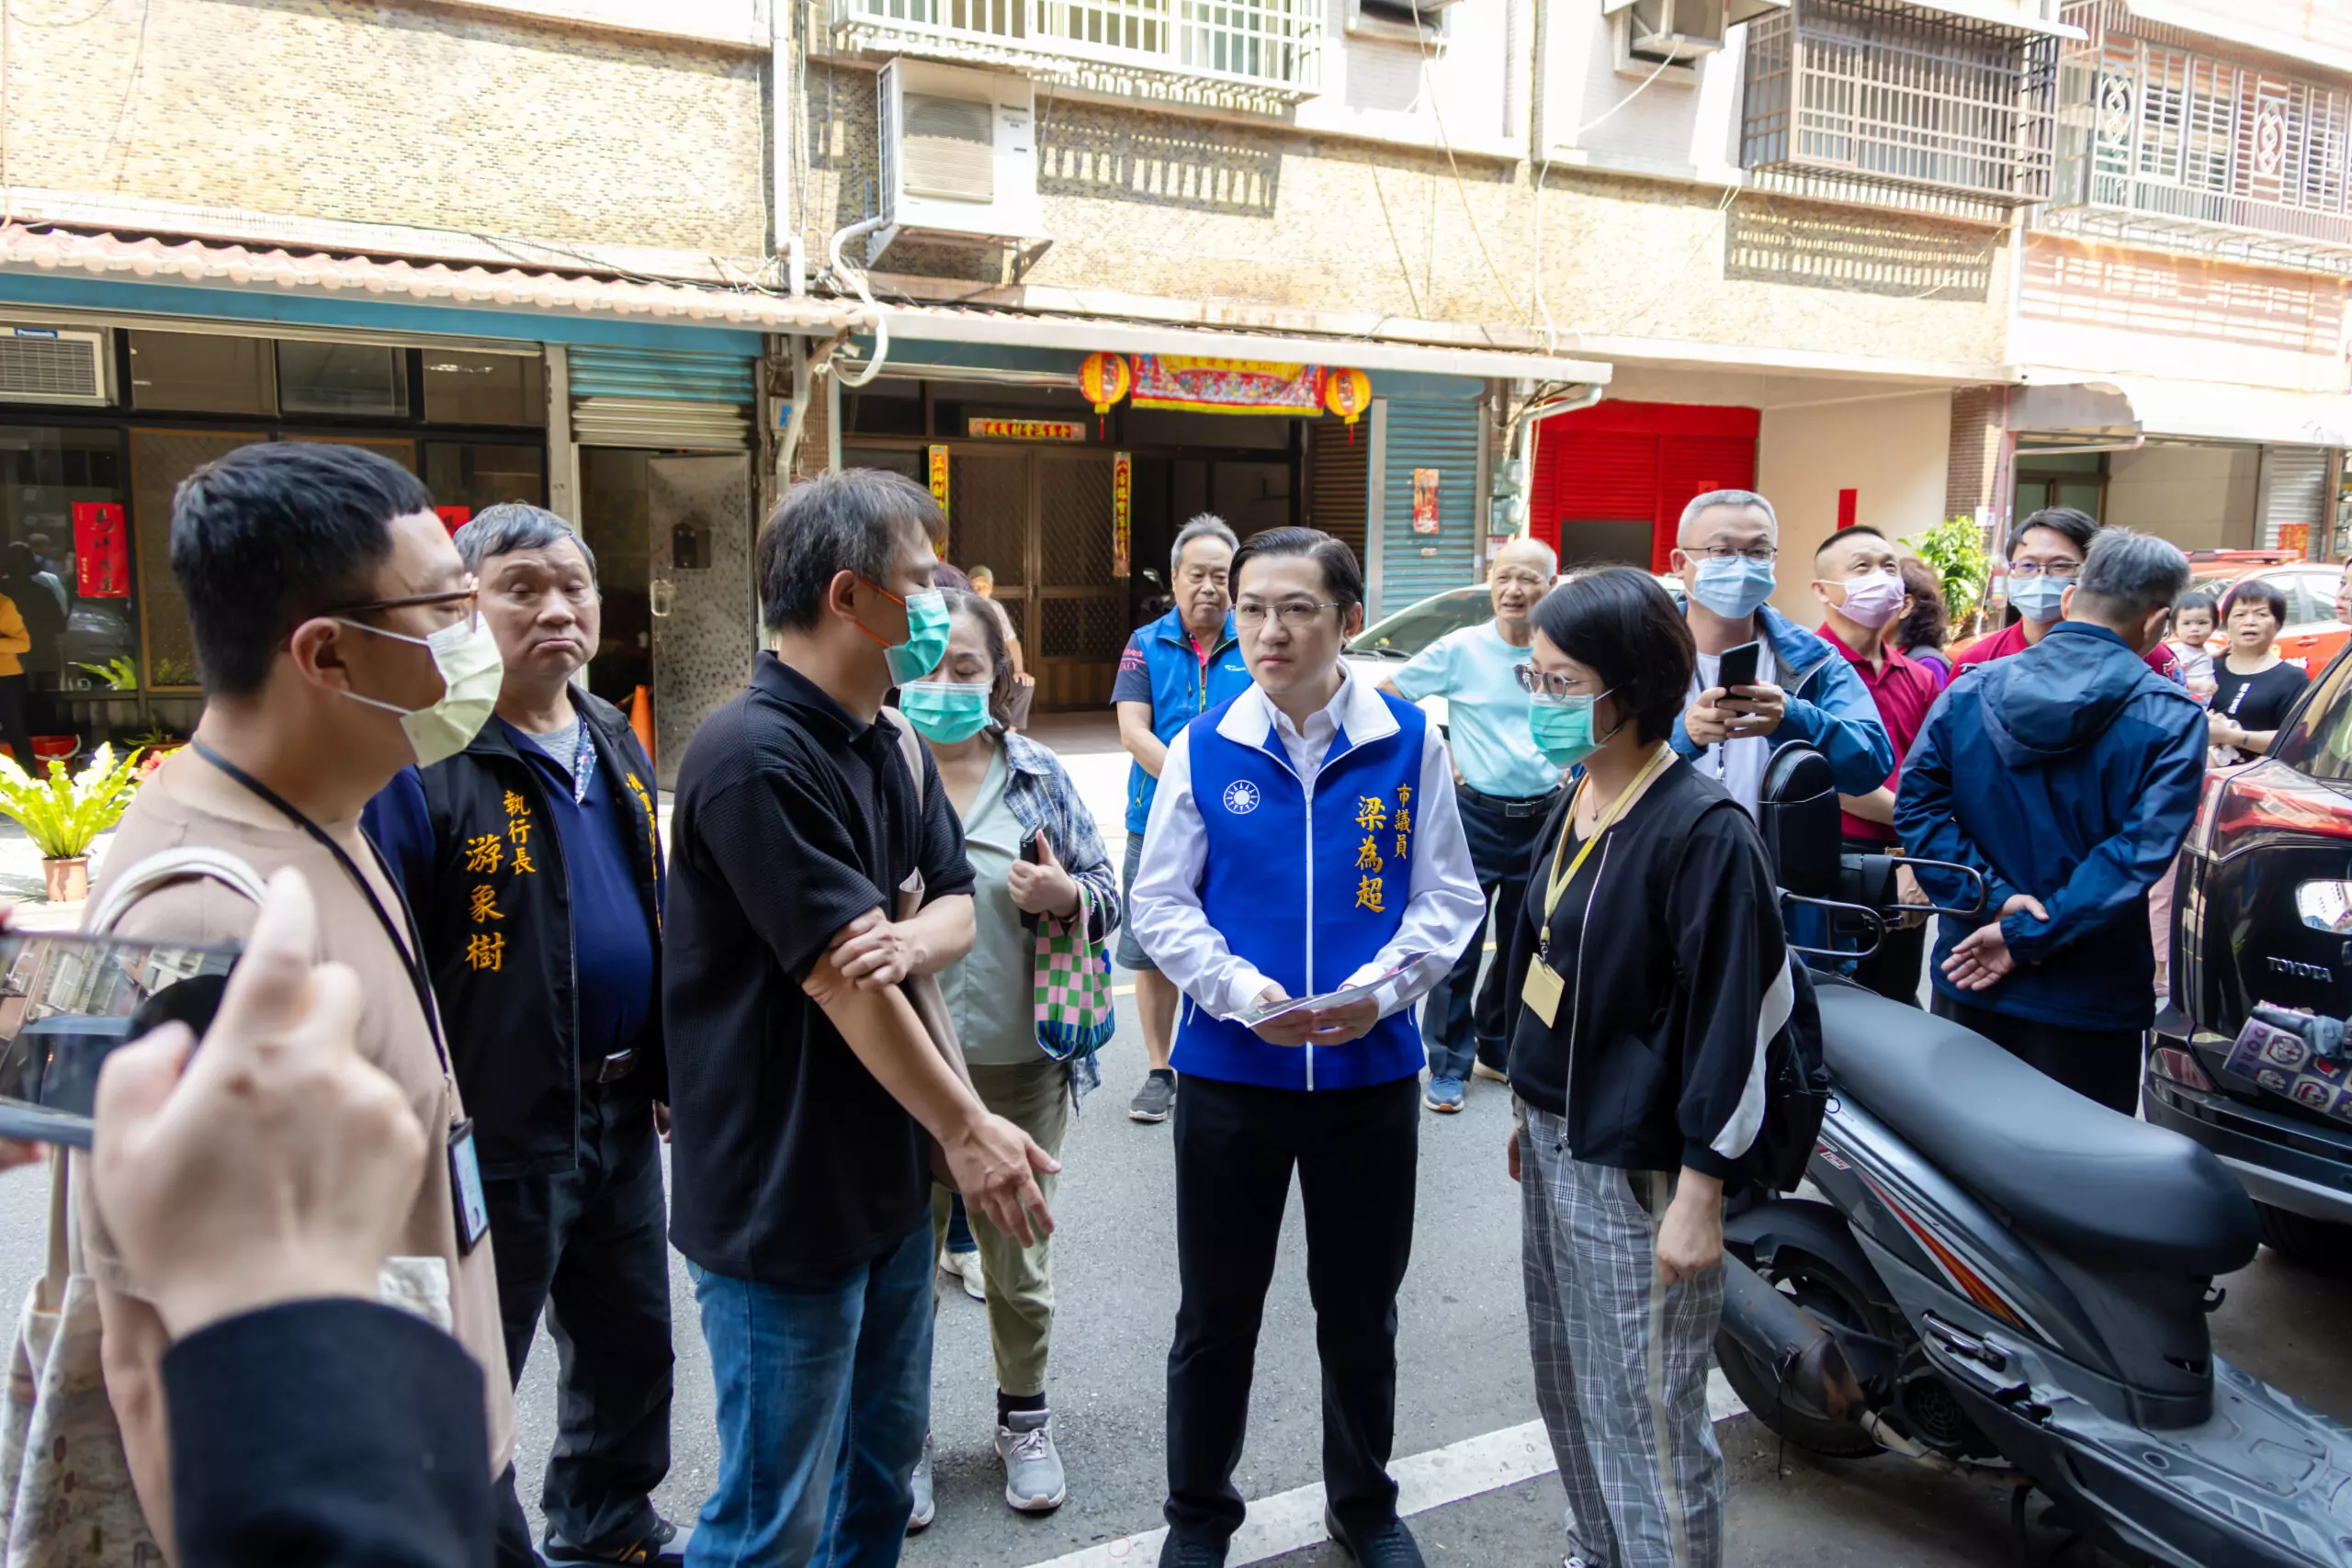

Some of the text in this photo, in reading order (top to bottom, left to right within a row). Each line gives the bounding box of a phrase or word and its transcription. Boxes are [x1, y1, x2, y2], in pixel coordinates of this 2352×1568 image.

[502, 789, 537, 876] 執行長
[1354, 795, 1387, 914] 梁為超
[1393, 783, 1413, 860] 市議員
[464, 833, 506, 973] 游象樹
[2266, 956, 2335, 983] TOYOTA
